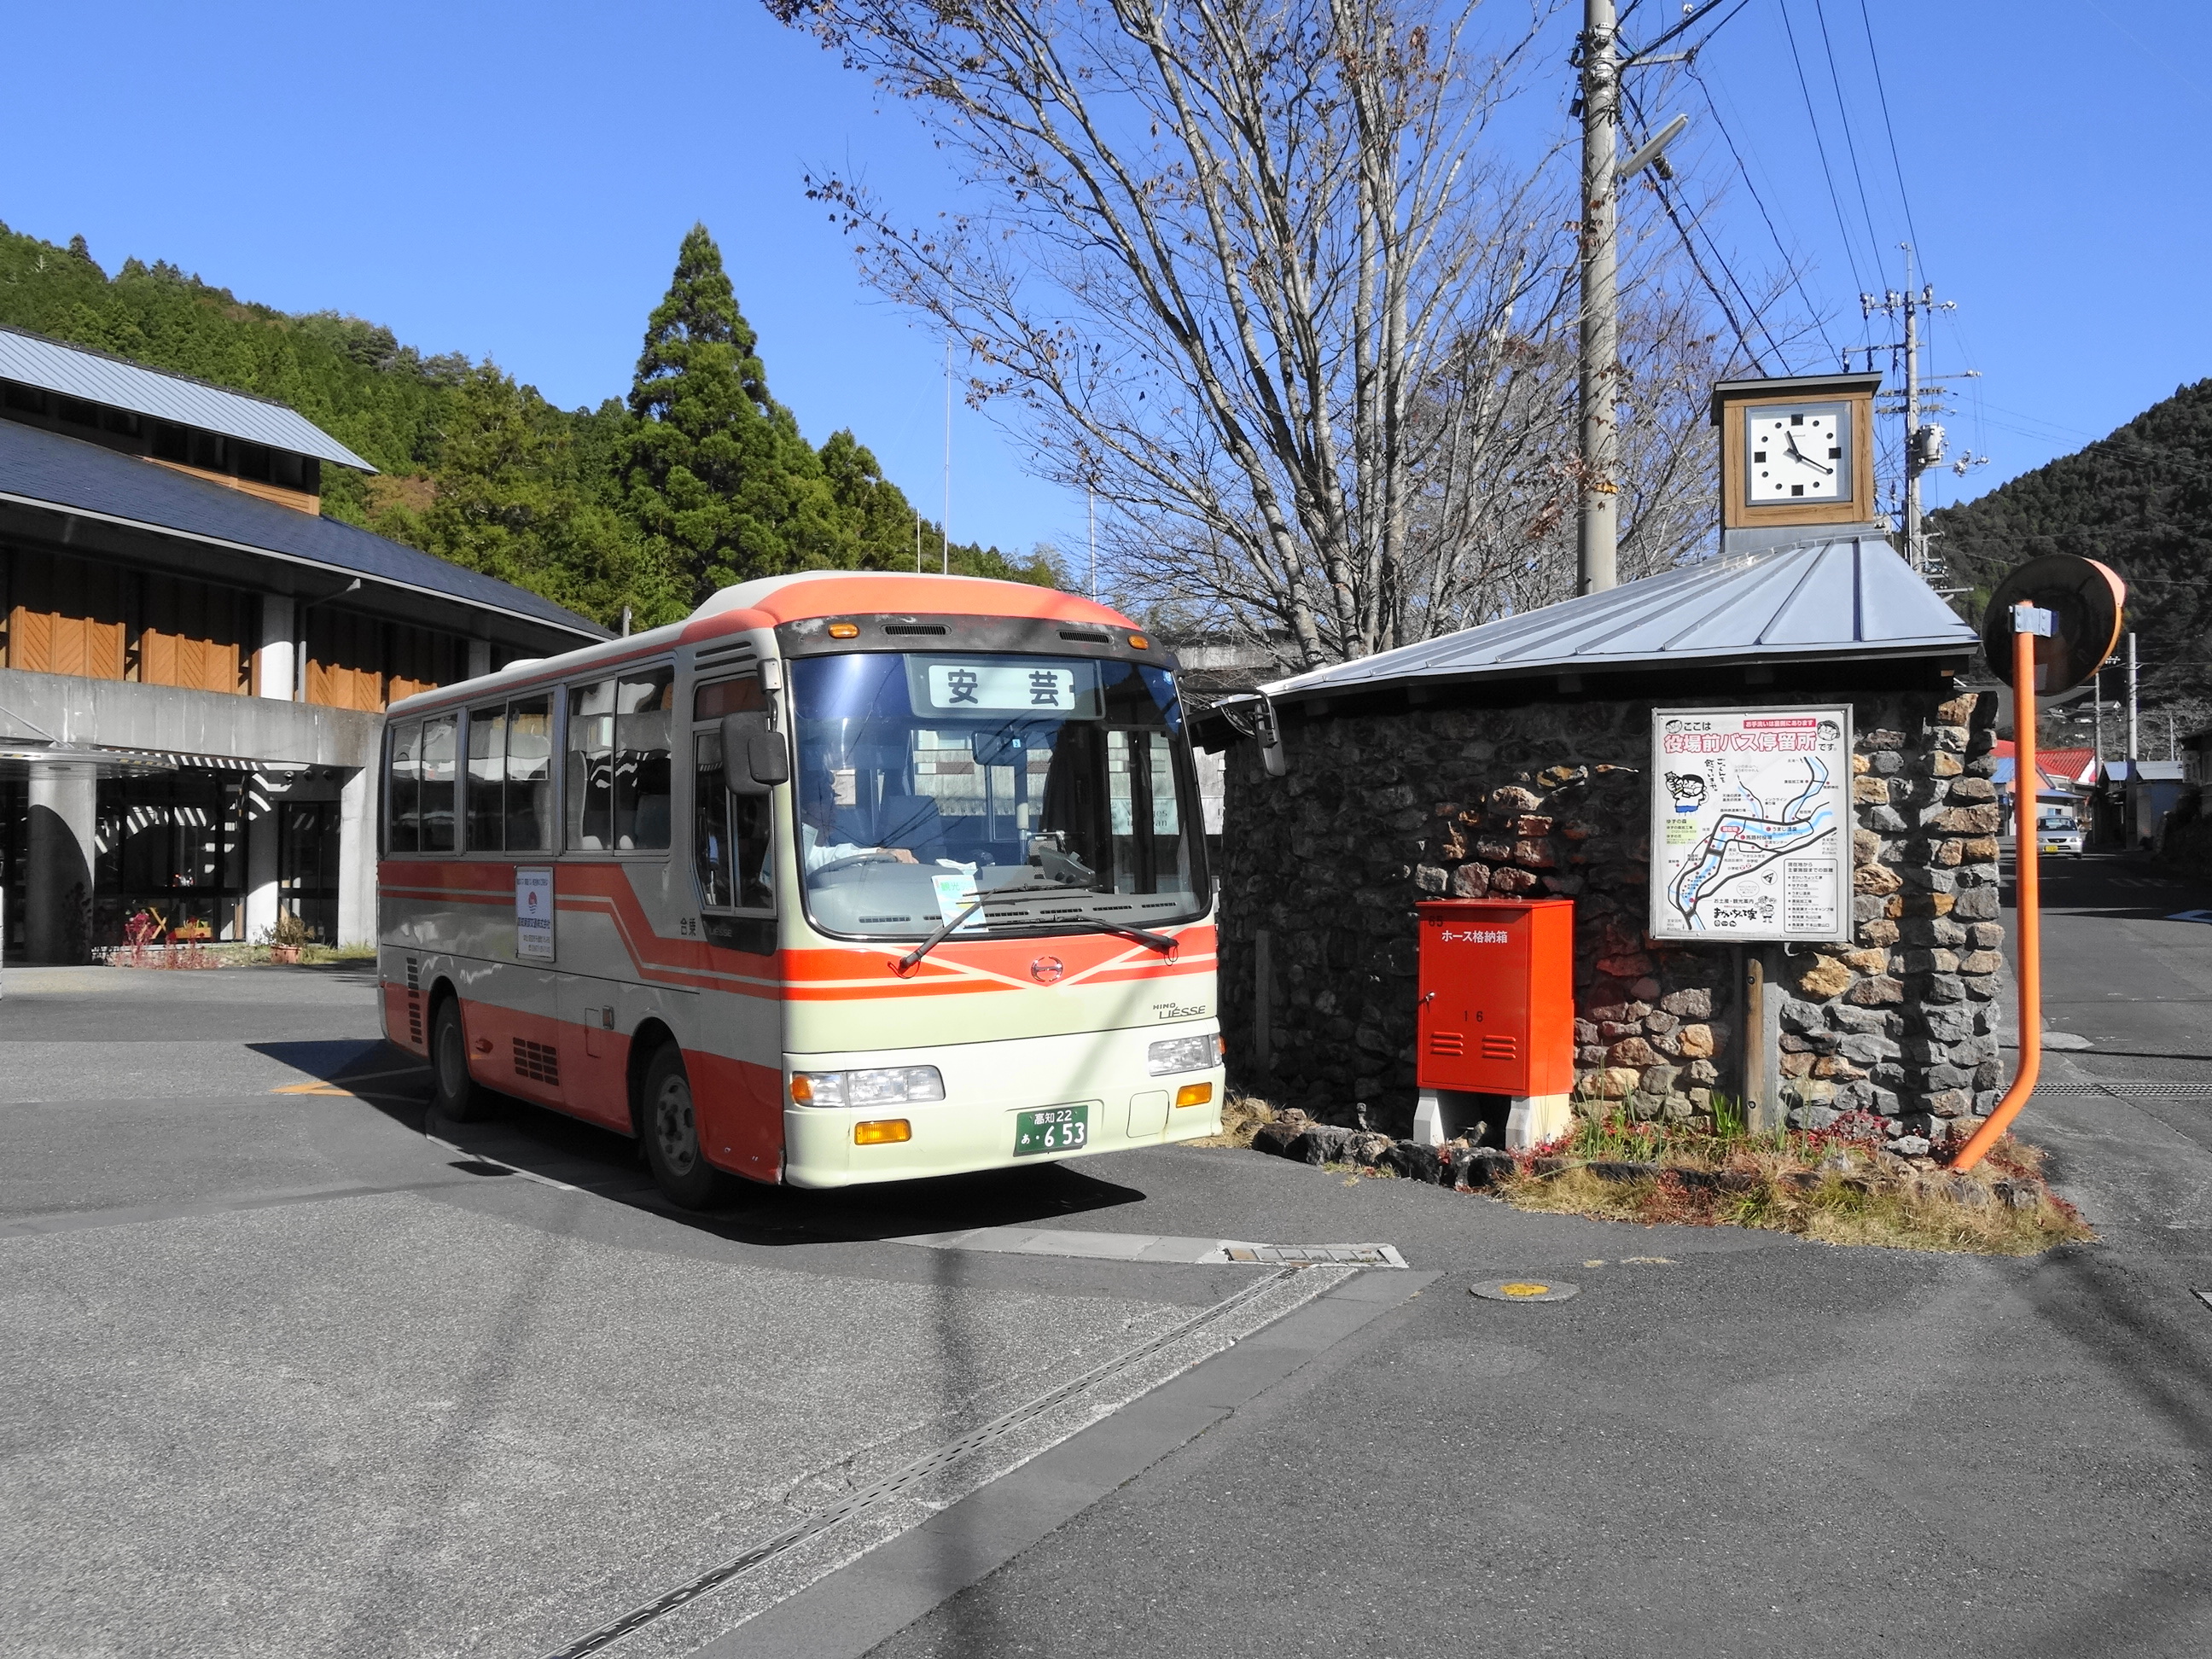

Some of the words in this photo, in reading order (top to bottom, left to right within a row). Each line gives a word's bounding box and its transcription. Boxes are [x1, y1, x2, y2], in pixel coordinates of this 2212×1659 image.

[947, 668, 1059, 707] 安芸
[1684, 722, 1712, 731] ここは
[1663, 731, 1818, 754] 役場前バス停留所
[1429, 916, 1443, 928] 65
[1441, 930, 1508, 944] ホース格納箱
[1152, 1002, 1176, 1010] HINO
